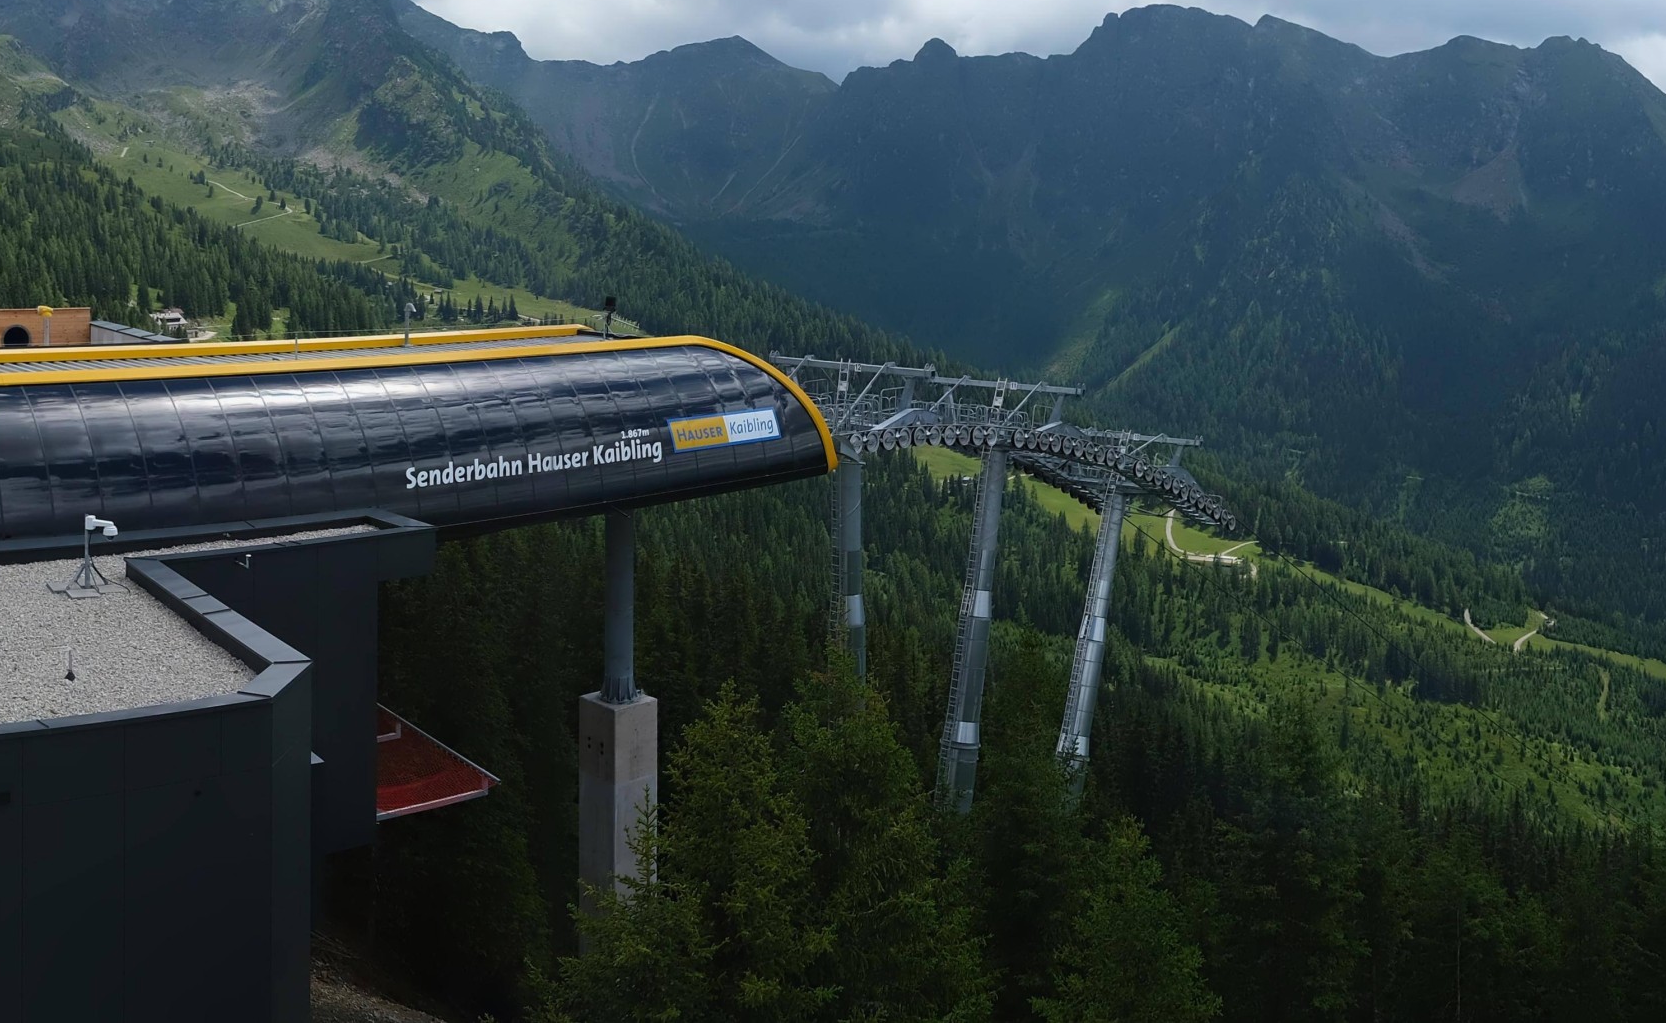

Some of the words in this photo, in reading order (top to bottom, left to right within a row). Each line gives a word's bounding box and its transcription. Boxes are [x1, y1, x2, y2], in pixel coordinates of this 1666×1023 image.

[620, 429, 650, 440] 1.867m
[676, 427, 724, 442] HAUSER
[729, 418, 774, 435] Kaibling
[406, 455, 523, 490] Senderbahn
[528, 449, 589, 474] Hauser
[592, 438, 663, 464] Kaibling
